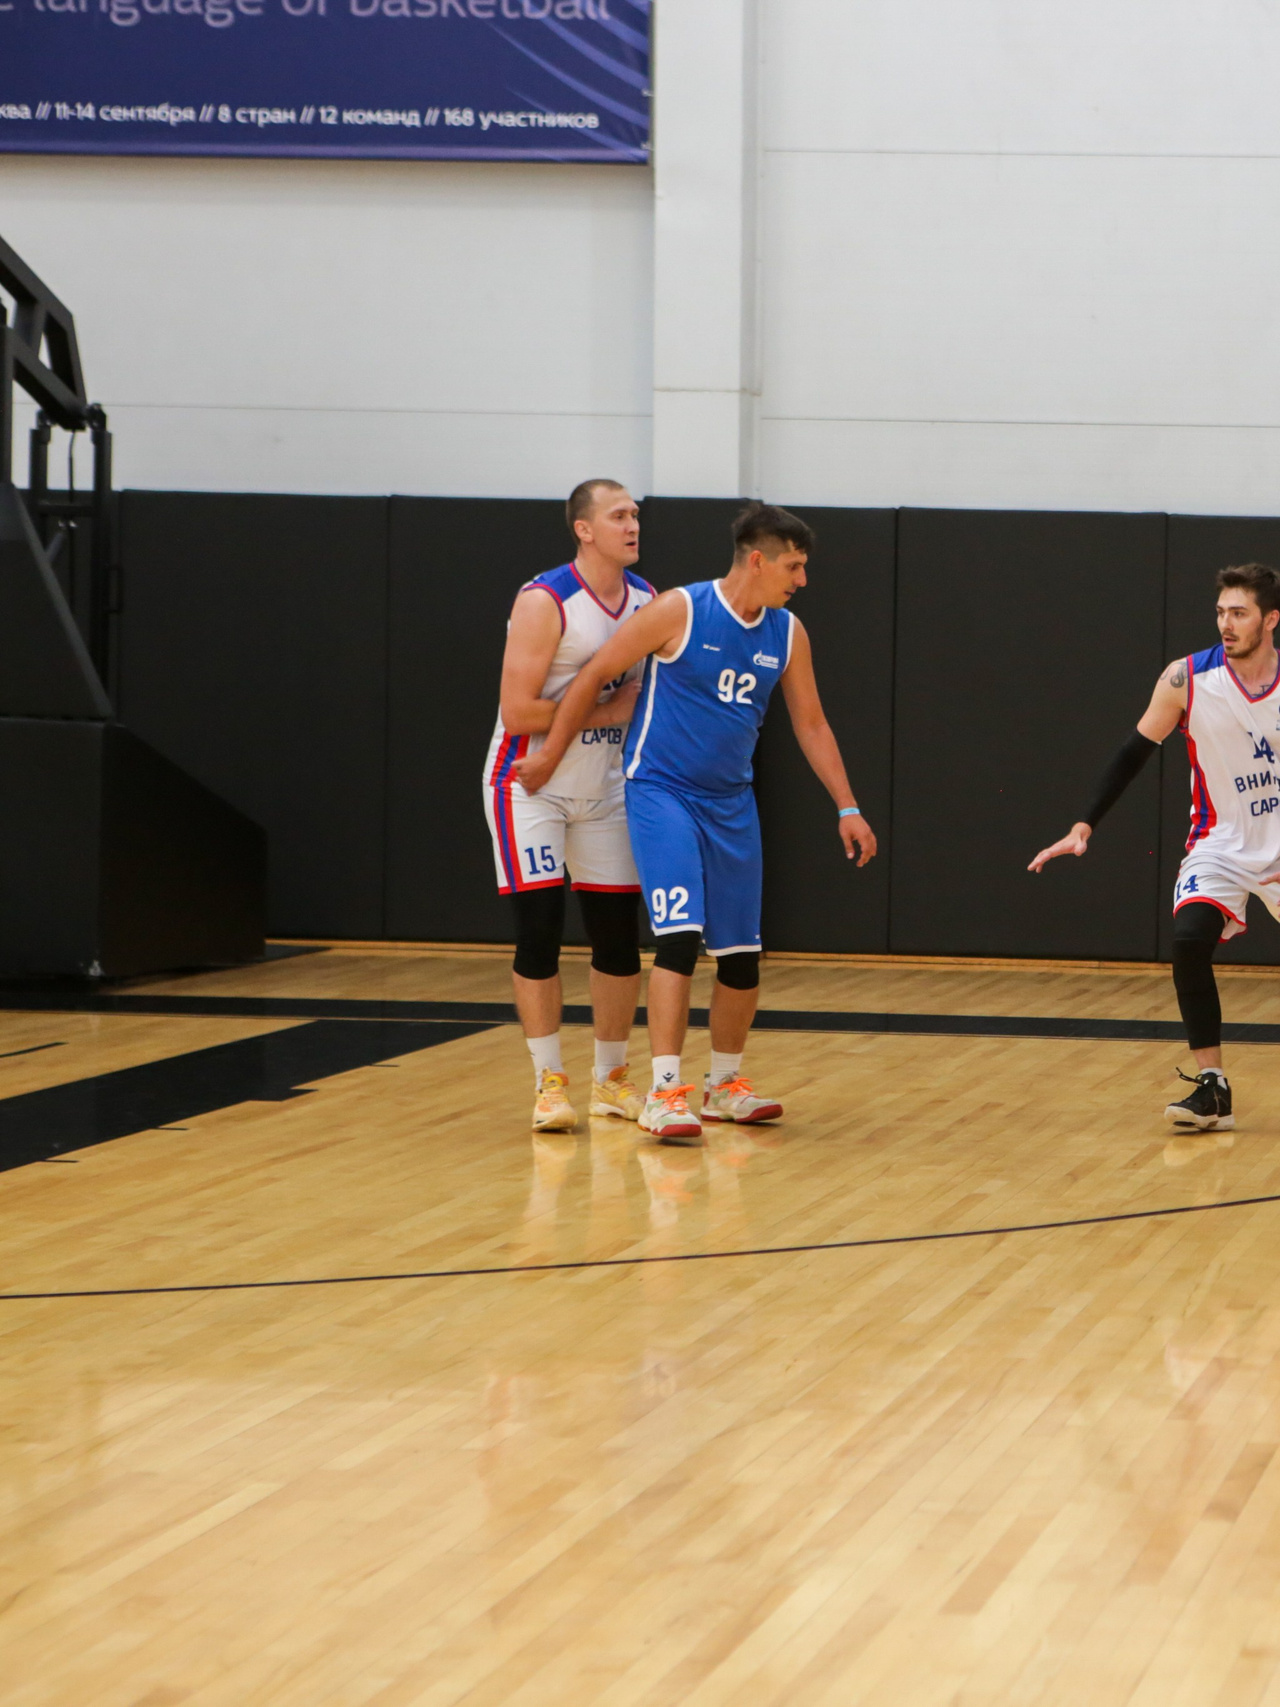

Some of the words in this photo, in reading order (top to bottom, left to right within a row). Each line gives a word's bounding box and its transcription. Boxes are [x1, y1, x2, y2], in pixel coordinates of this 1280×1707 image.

[54, 101, 96, 120] 11-14
[99, 101, 197, 127] сентября
[218, 103, 232, 123] 8
[235, 107, 297, 128] стран
[318, 105, 338, 125] 12
[342, 109, 421, 127] команд
[443, 107, 475, 127] 168
[479, 111, 600, 130] участников
[717, 668, 757, 704] 92
[581, 728, 622, 744] САРОВ
[524, 845, 557, 875] 15
[1175, 874, 1199, 902] 14
[651, 886, 689, 923] 92
